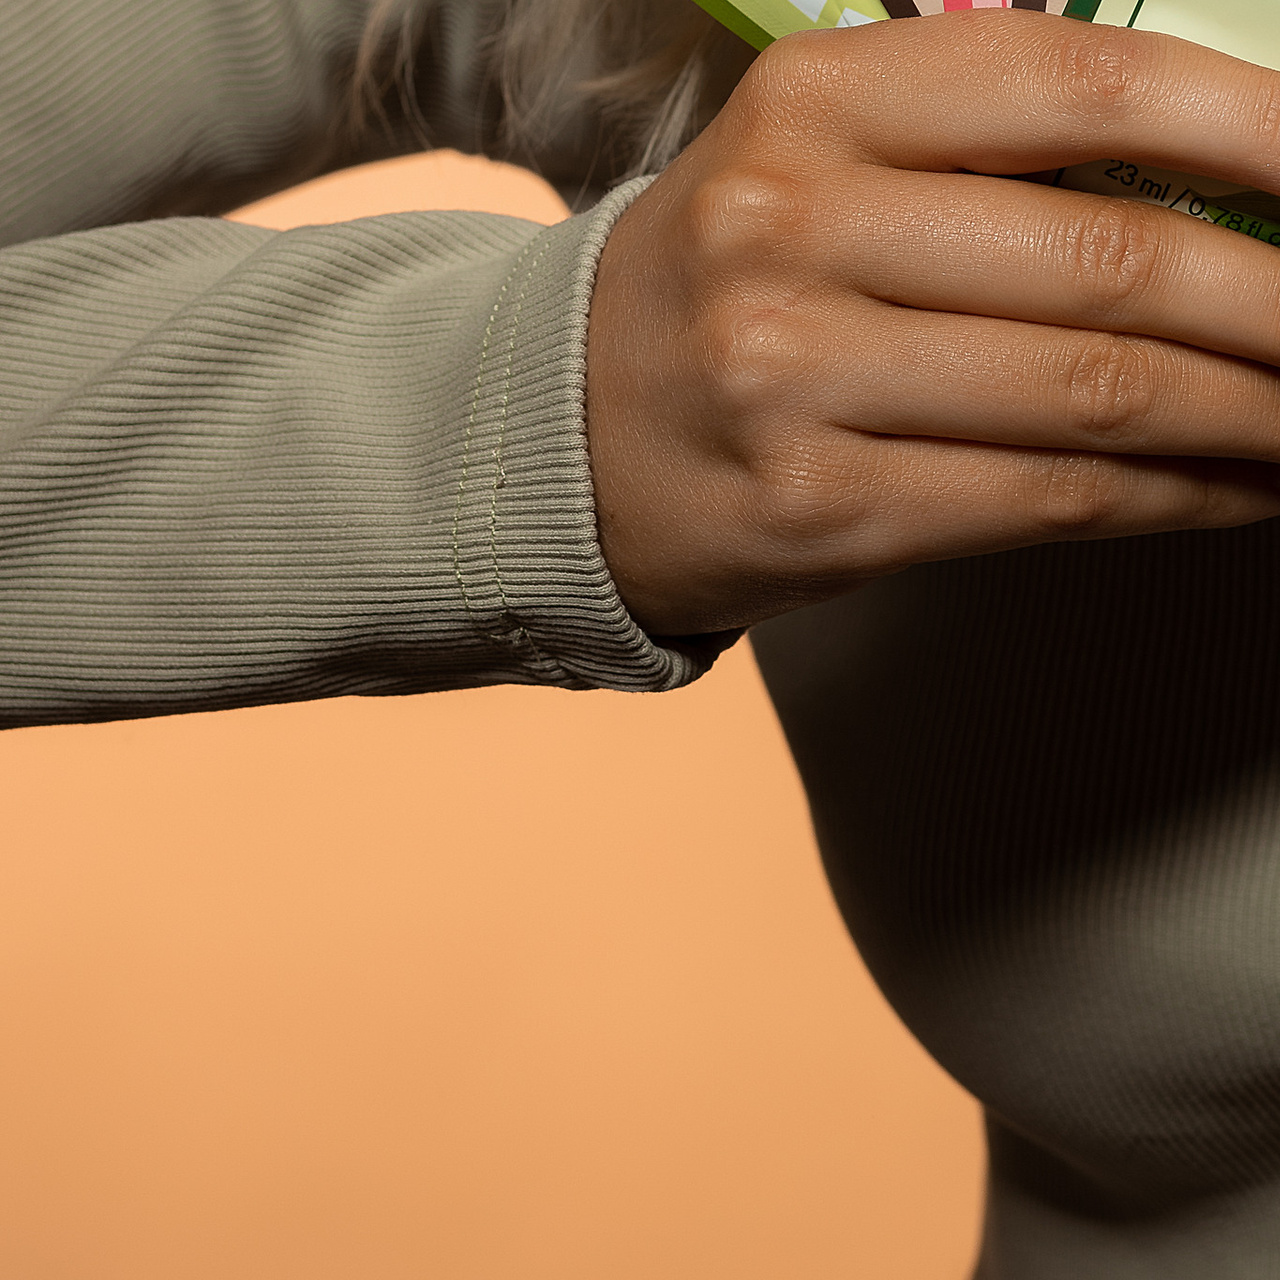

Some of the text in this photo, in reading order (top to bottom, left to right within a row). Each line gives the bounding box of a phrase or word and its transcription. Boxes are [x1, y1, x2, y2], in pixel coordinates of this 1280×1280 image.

[1104, 159, 1139, 186] 23
[1139, 177, 1172, 202] ml
[1168, 189, 1190, 209] /
[1188, 197, 1245, 233] 0.78
